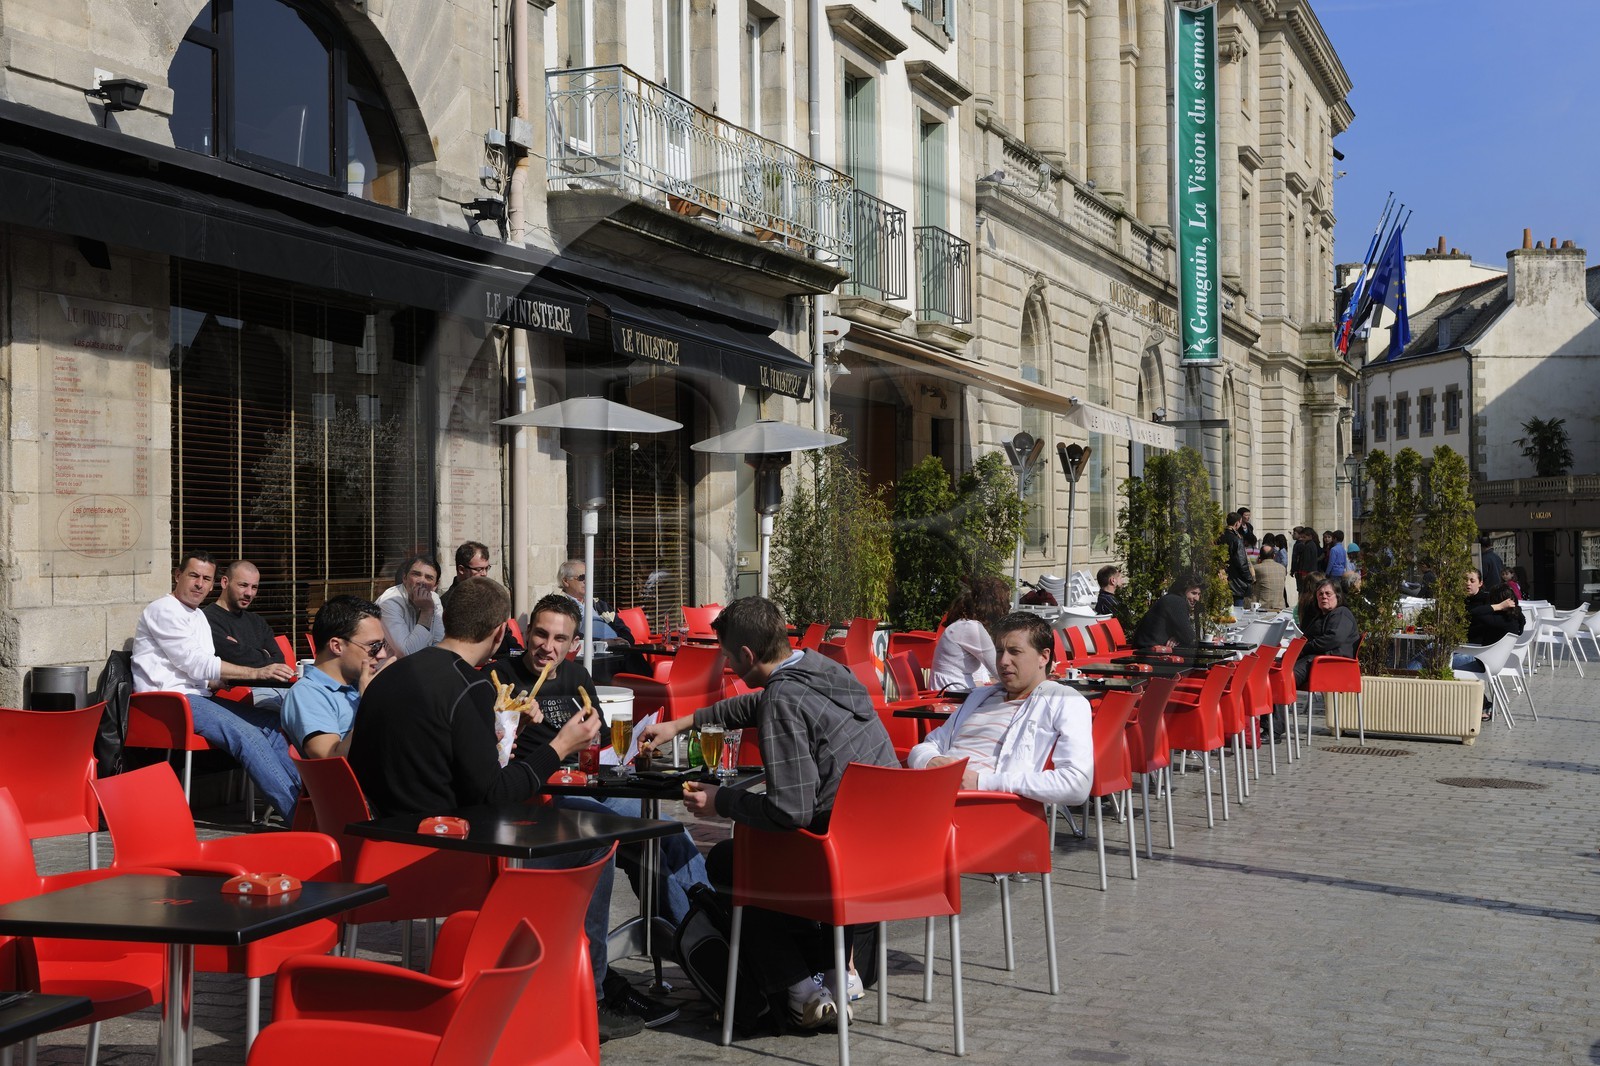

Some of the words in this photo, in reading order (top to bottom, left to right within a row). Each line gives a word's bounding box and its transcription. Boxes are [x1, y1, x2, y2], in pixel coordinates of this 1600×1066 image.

[1194, 14, 1206, 90] sermon
[1188, 97, 1206, 126] du
[1188, 131, 1207, 196] Vision
[1189, 201, 1206, 228] La
[1190, 237, 1214, 333] Gauguin,
[67, 306, 78, 323] LE
[485, 291, 502, 319] LE
[506, 295, 574, 335] FINISTERE
[621, 327, 634, 353] LE
[760, 365, 770, 388] LE
[73, 506, 82, 514] Les
[83, 506, 106, 514] omelettes
